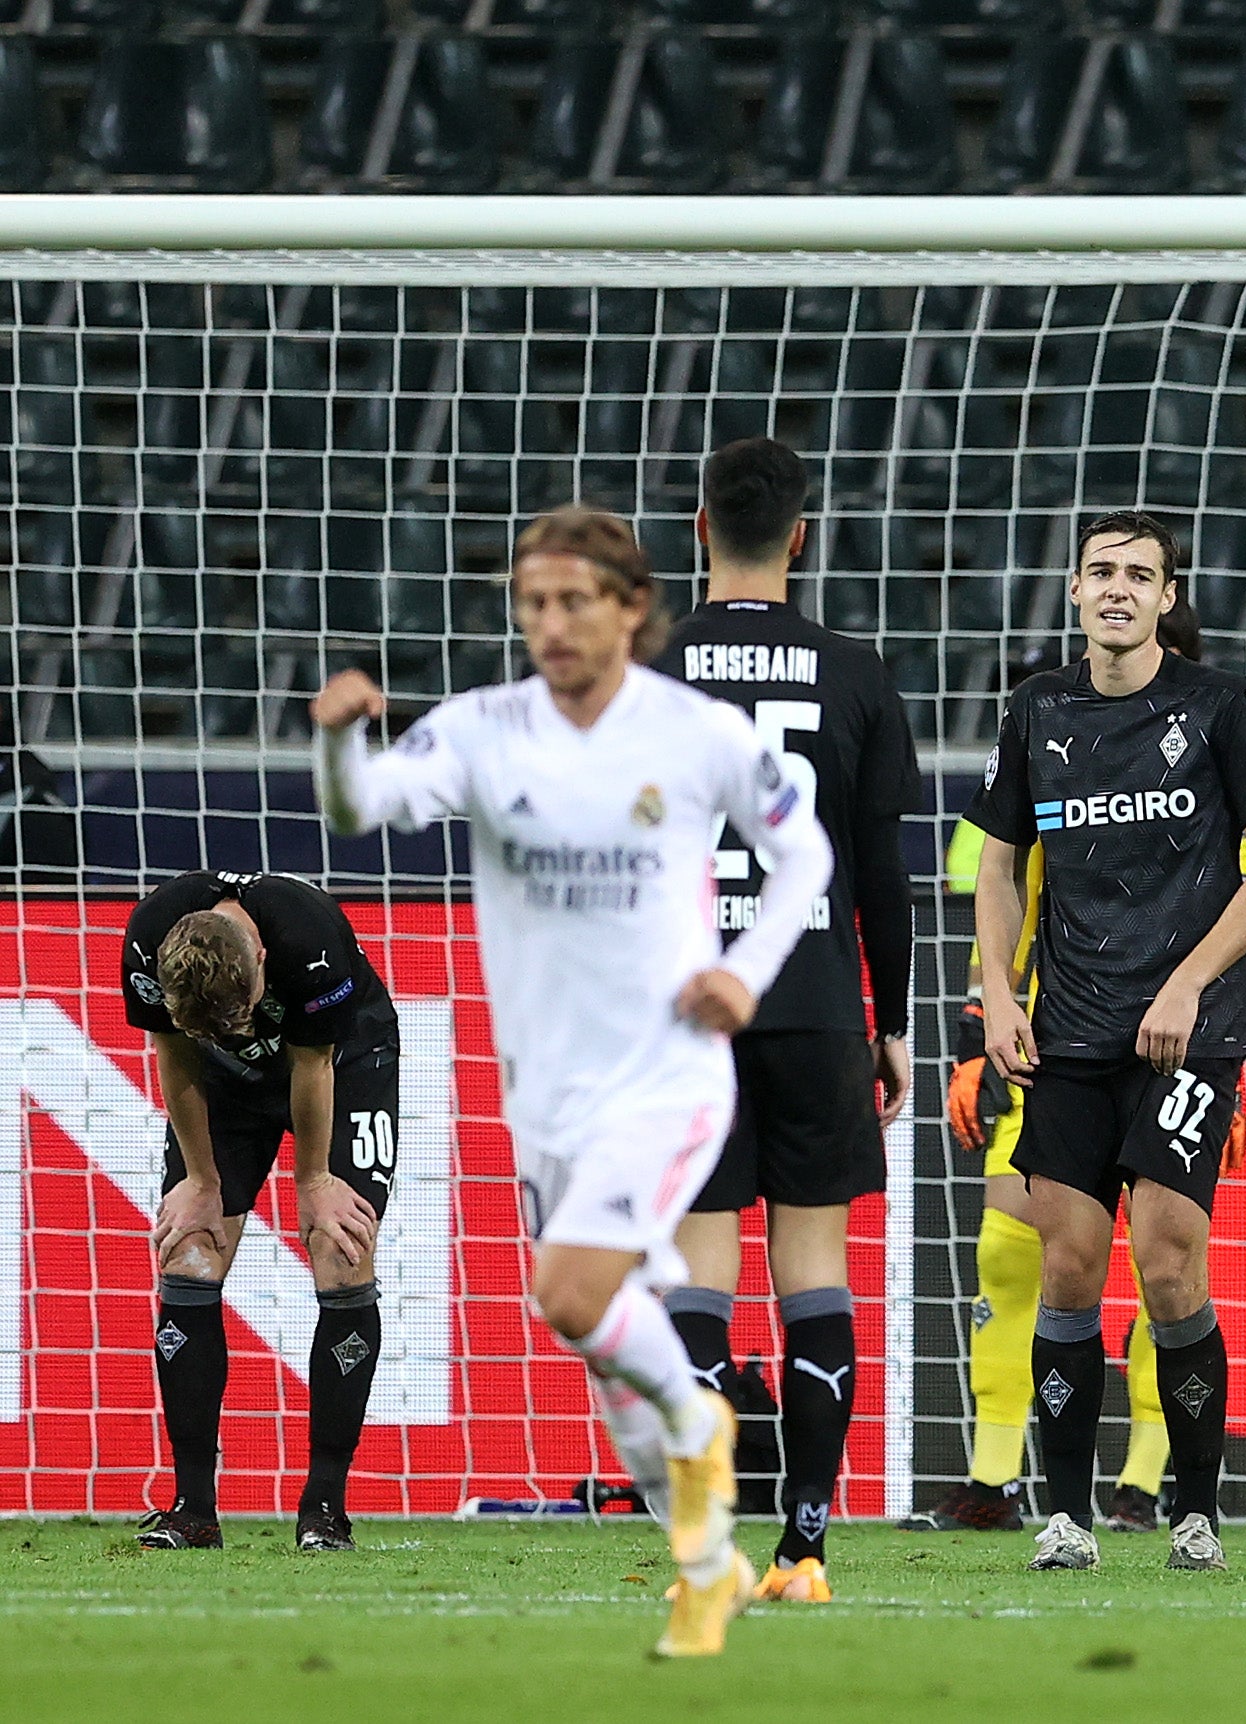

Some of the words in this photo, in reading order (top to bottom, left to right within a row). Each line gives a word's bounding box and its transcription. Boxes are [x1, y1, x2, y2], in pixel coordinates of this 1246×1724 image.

[684, 644, 818, 686] BENSEBAINI
[1065, 788, 1196, 828] DEGIRO
[1157, 1068, 1215, 1144] 32
[350, 1110, 394, 1169] 30
